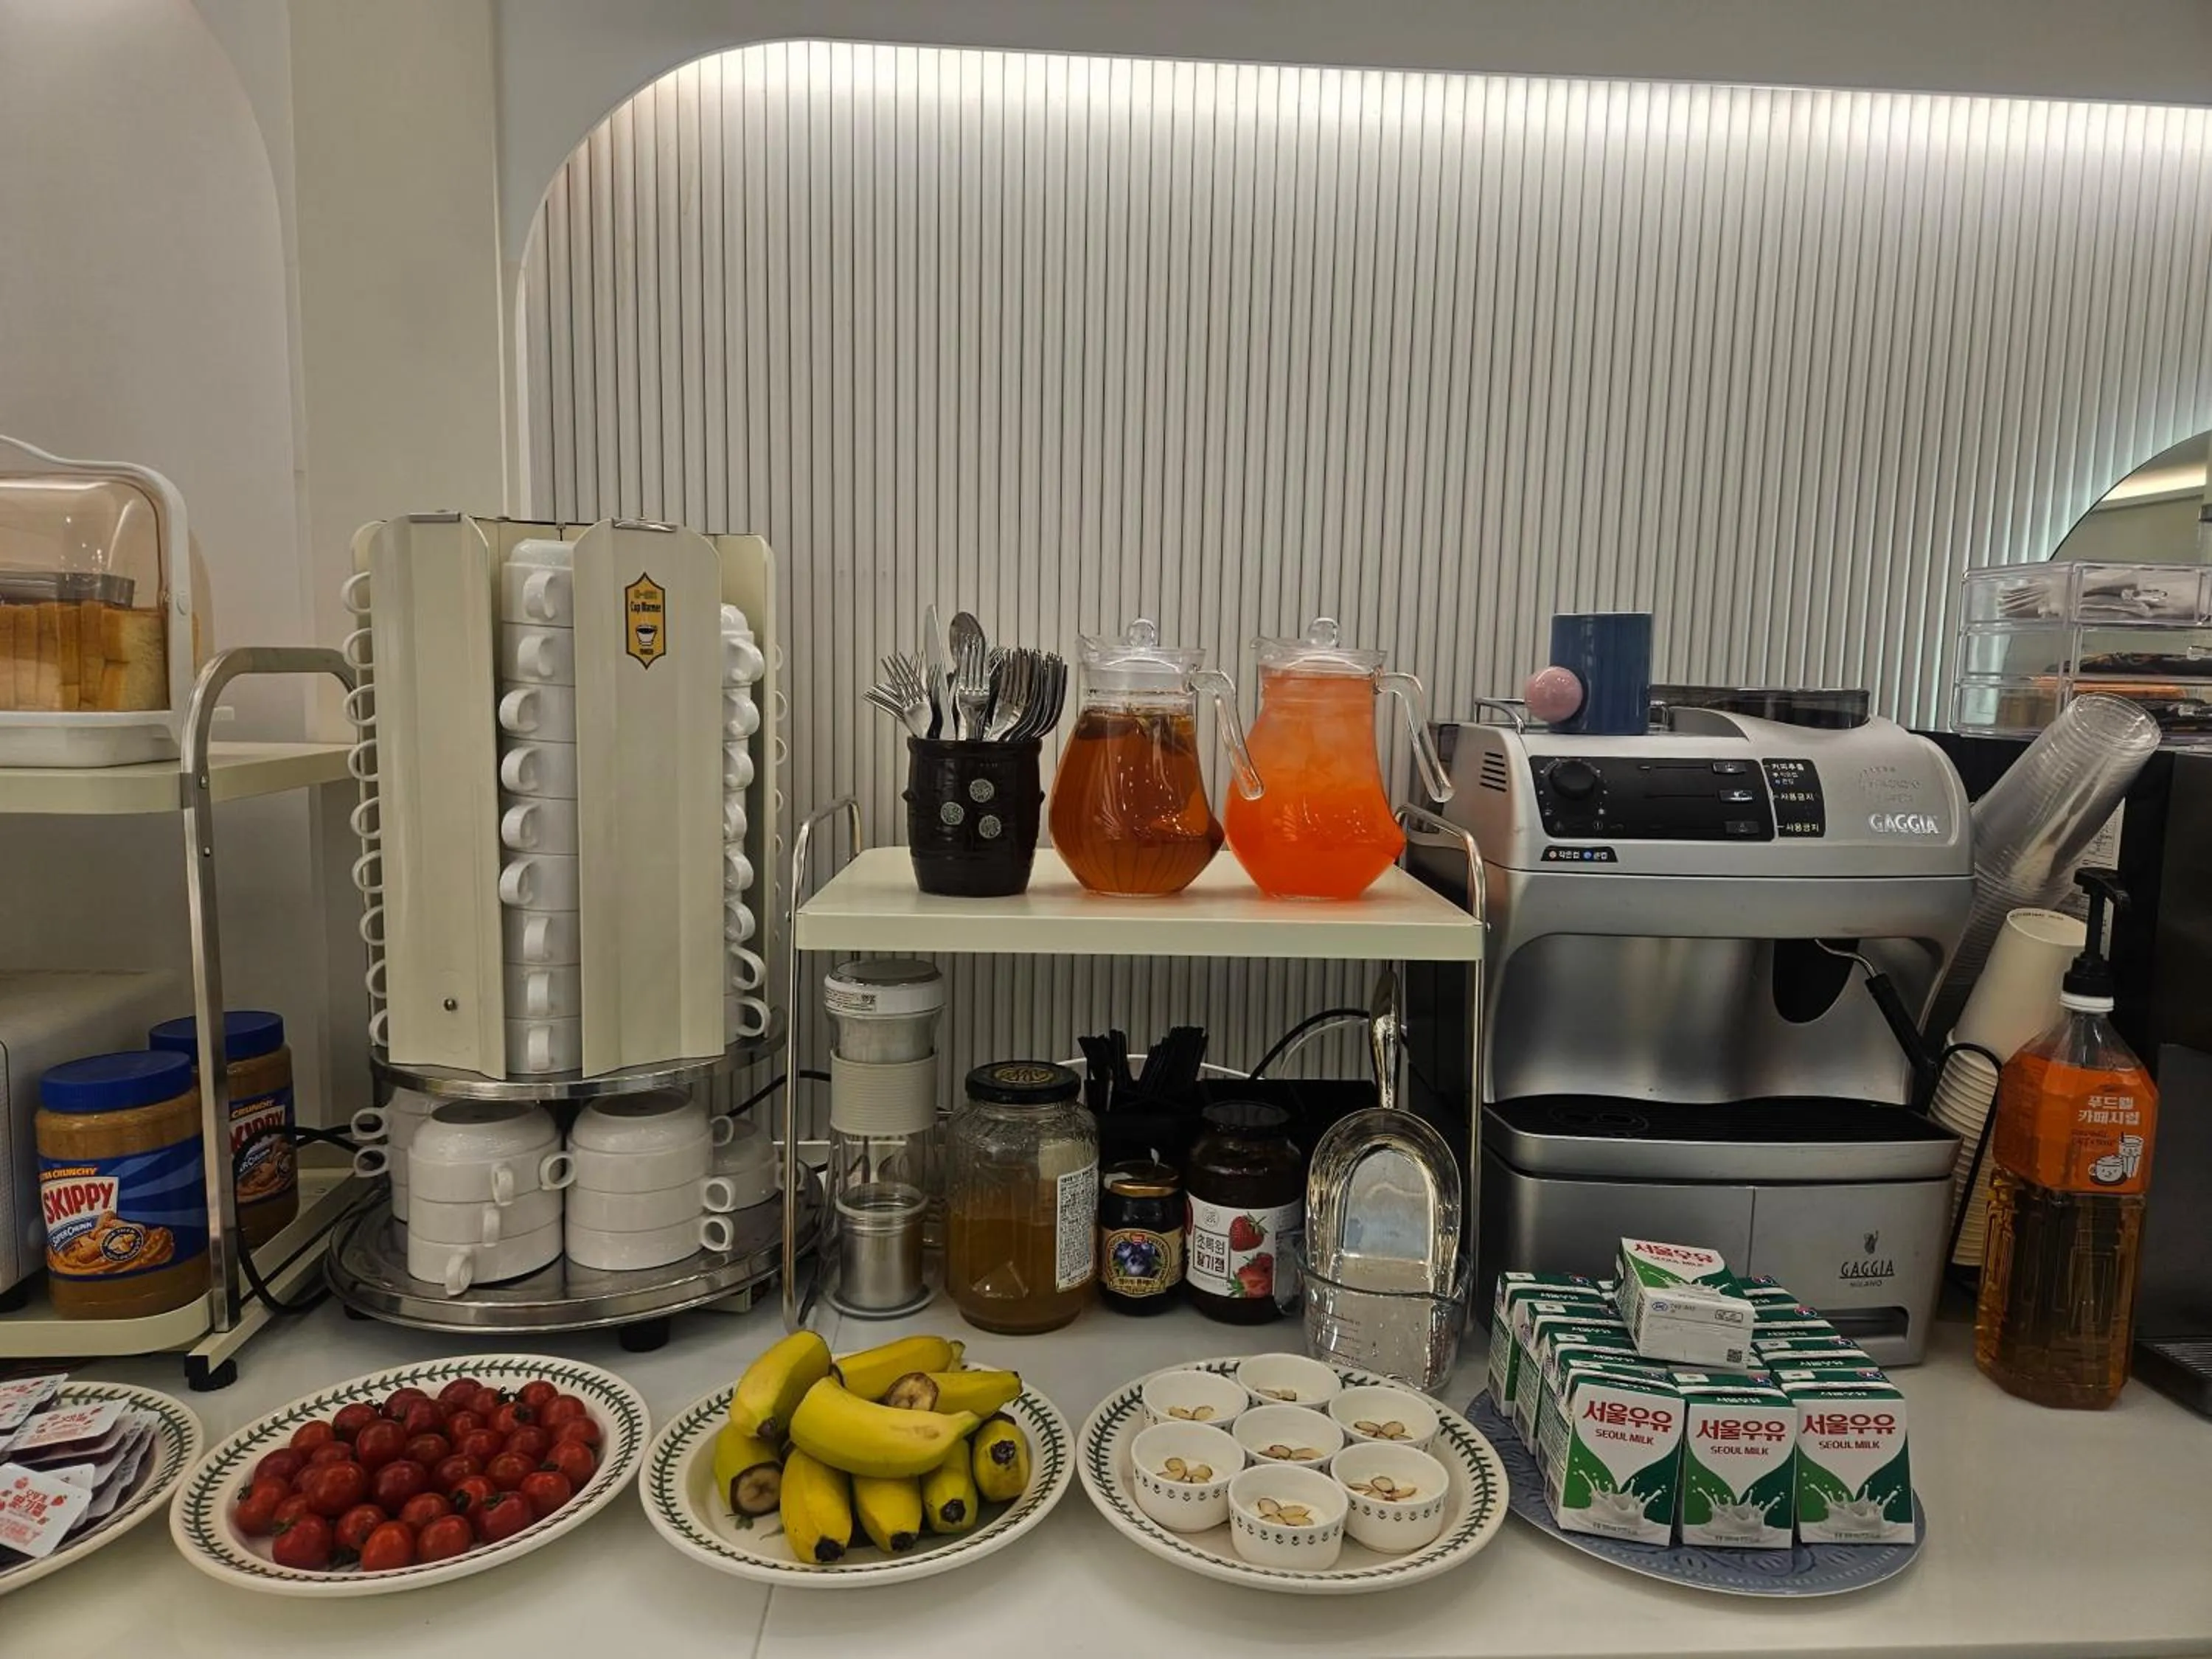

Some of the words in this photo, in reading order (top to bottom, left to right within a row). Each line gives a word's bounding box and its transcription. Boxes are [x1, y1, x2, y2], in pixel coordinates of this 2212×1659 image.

[1868, 813, 1941, 835] GAGGIA
[230, 1110, 283, 1152] KIPPY
[52, 1167, 95, 1178] CRUNCHY
[42, 1181, 114, 1224] SKIPPY
[1634, 1242, 1714, 1263] 서울우유
[1840, 1259, 1895, 1279] GAGGIA
[1582, 1399, 1673, 1434] 서울우유
[1801, 1413, 1896, 1435] 서울우유
[1596, 1428, 1628, 1442] SEOUL
[1628, 1434, 1655, 1446] MILK
[1695, 1419, 1786, 1441] 서울우유
[1710, 1445, 1745, 1455] SEOUL
[1745, 1446, 1770, 1455] MILK
[1818, 1441, 1854, 1450] SEOUL
[1854, 1441, 1880, 1450] MILK
